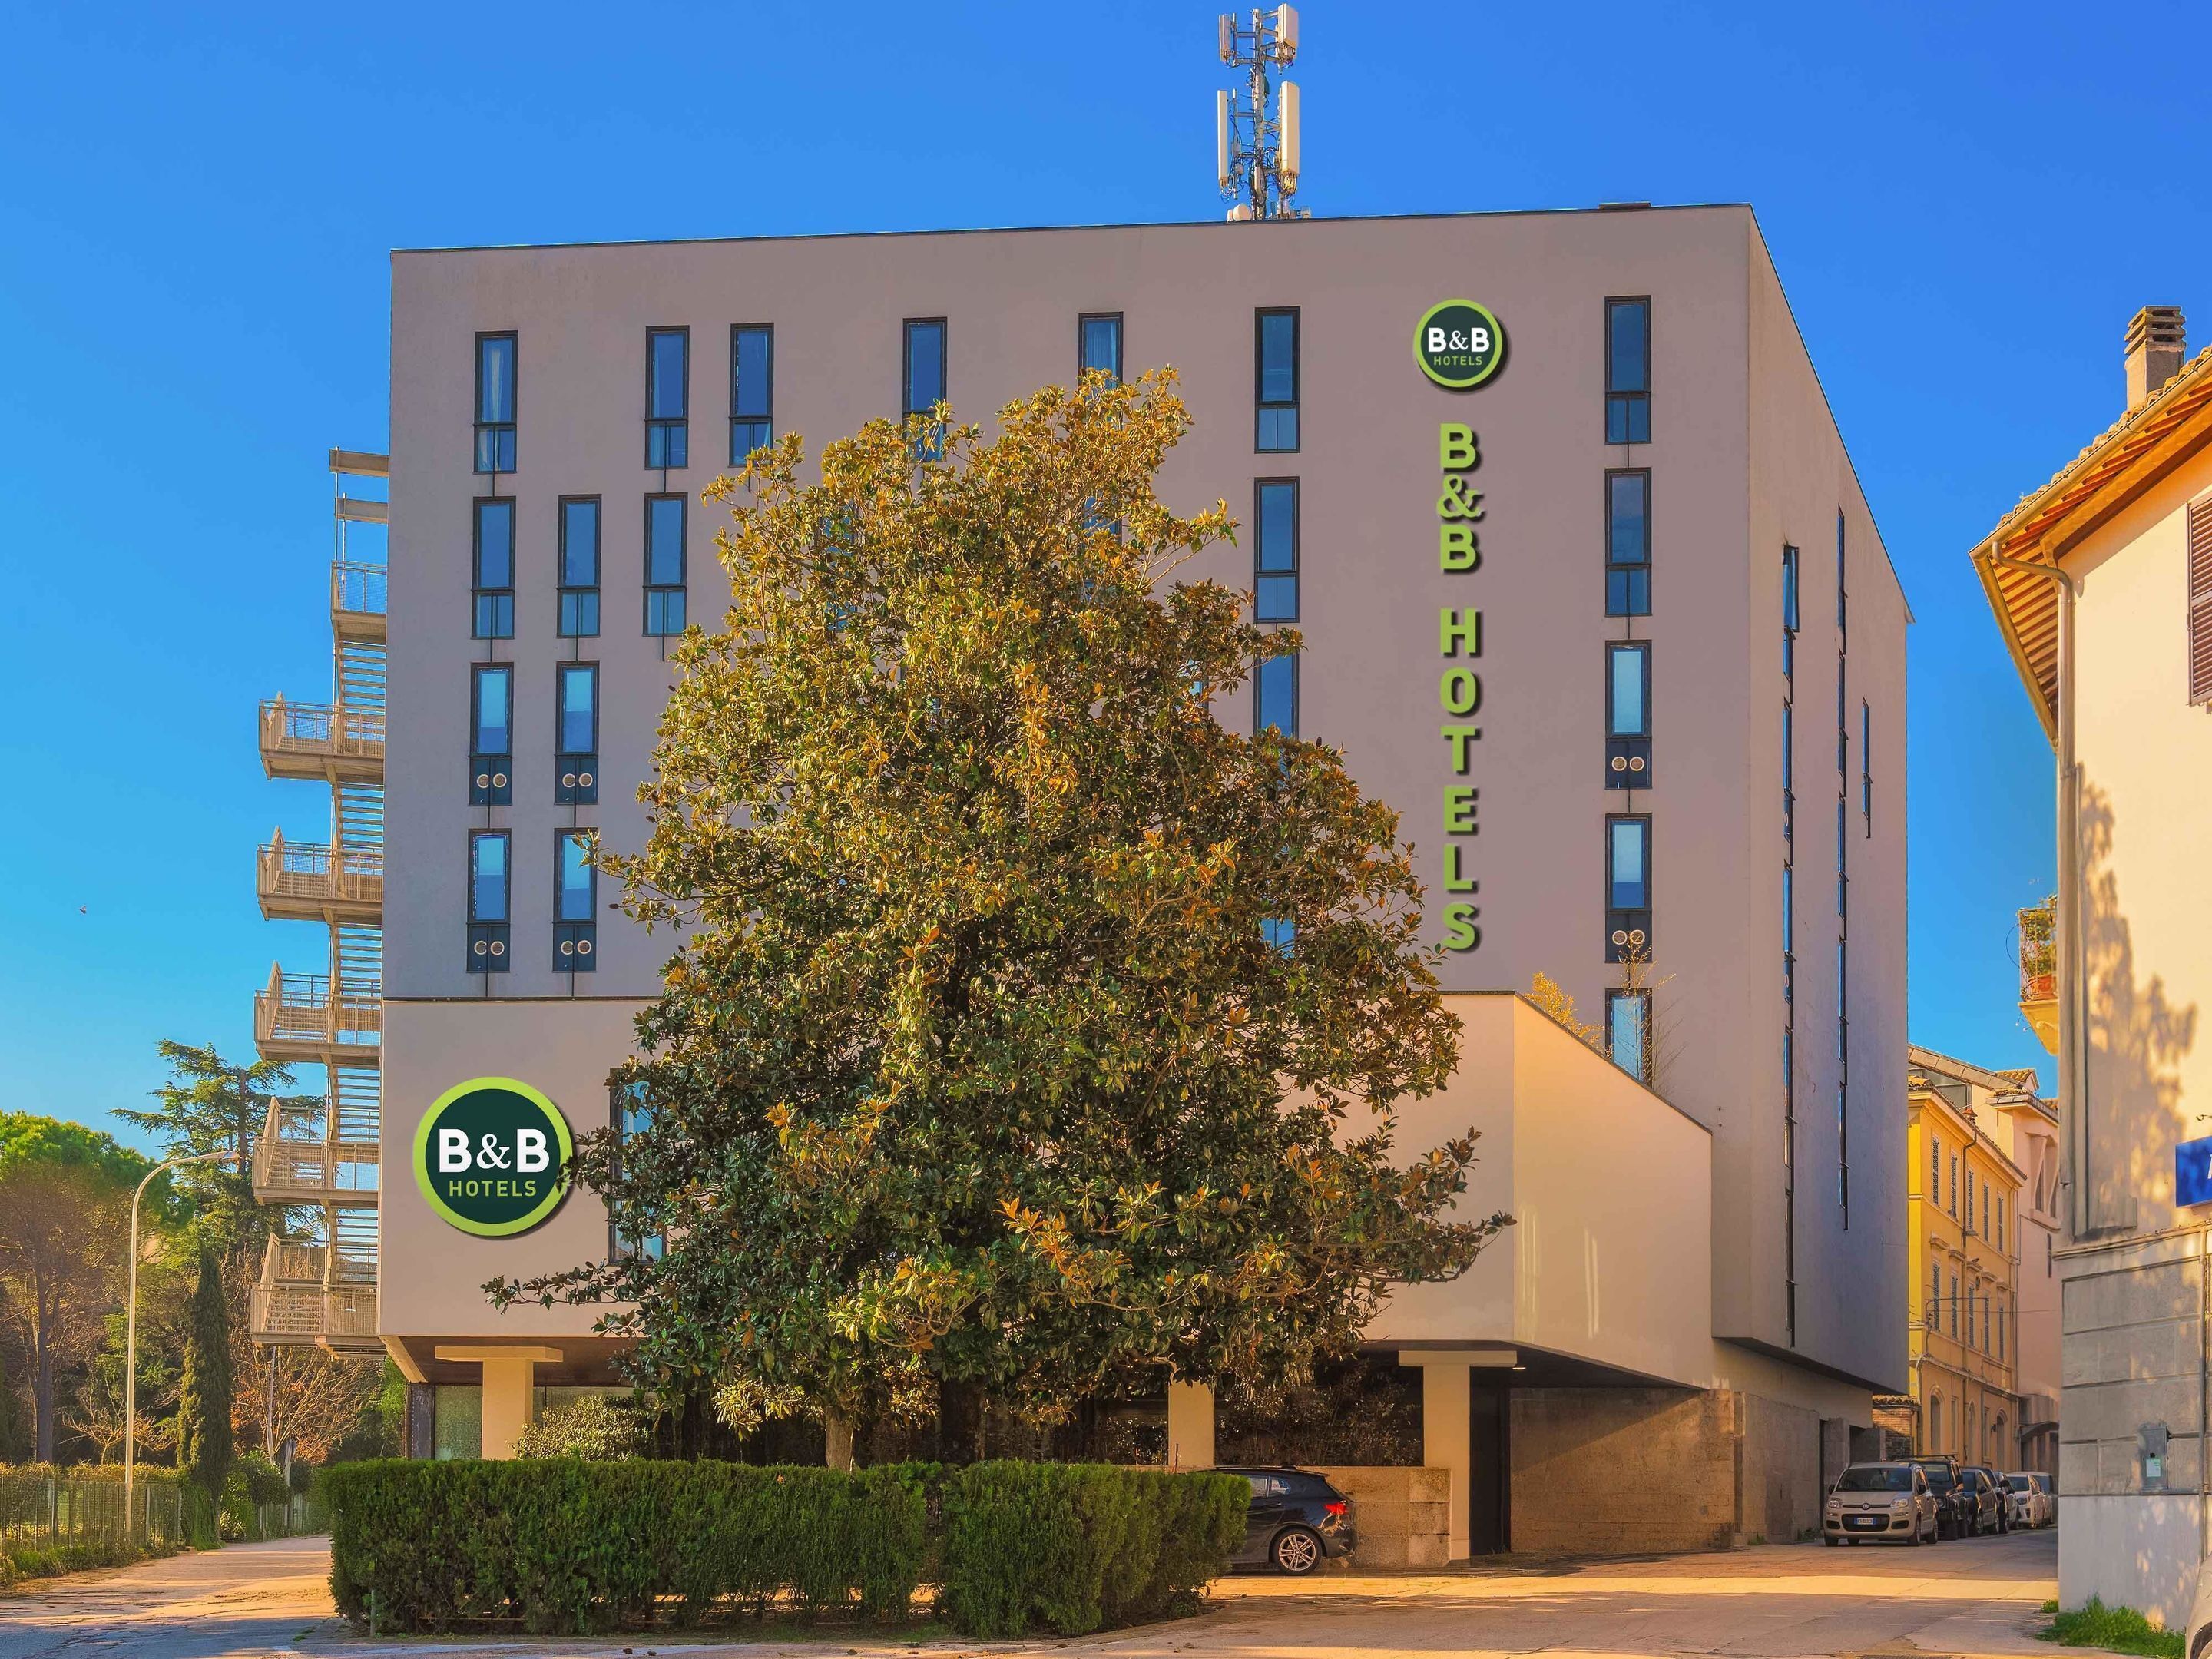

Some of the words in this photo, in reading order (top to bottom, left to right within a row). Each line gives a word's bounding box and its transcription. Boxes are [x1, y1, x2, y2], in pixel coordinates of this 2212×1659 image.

[1428, 327, 1490, 353] B&B
[1433, 356, 1483, 366] HOTELS
[1436, 422, 1483, 569] B&B
[1439, 608, 1478, 950] HOTELS
[439, 1128, 550, 1173] B&B
[449, 1180, 537, 1197] HOTELS
